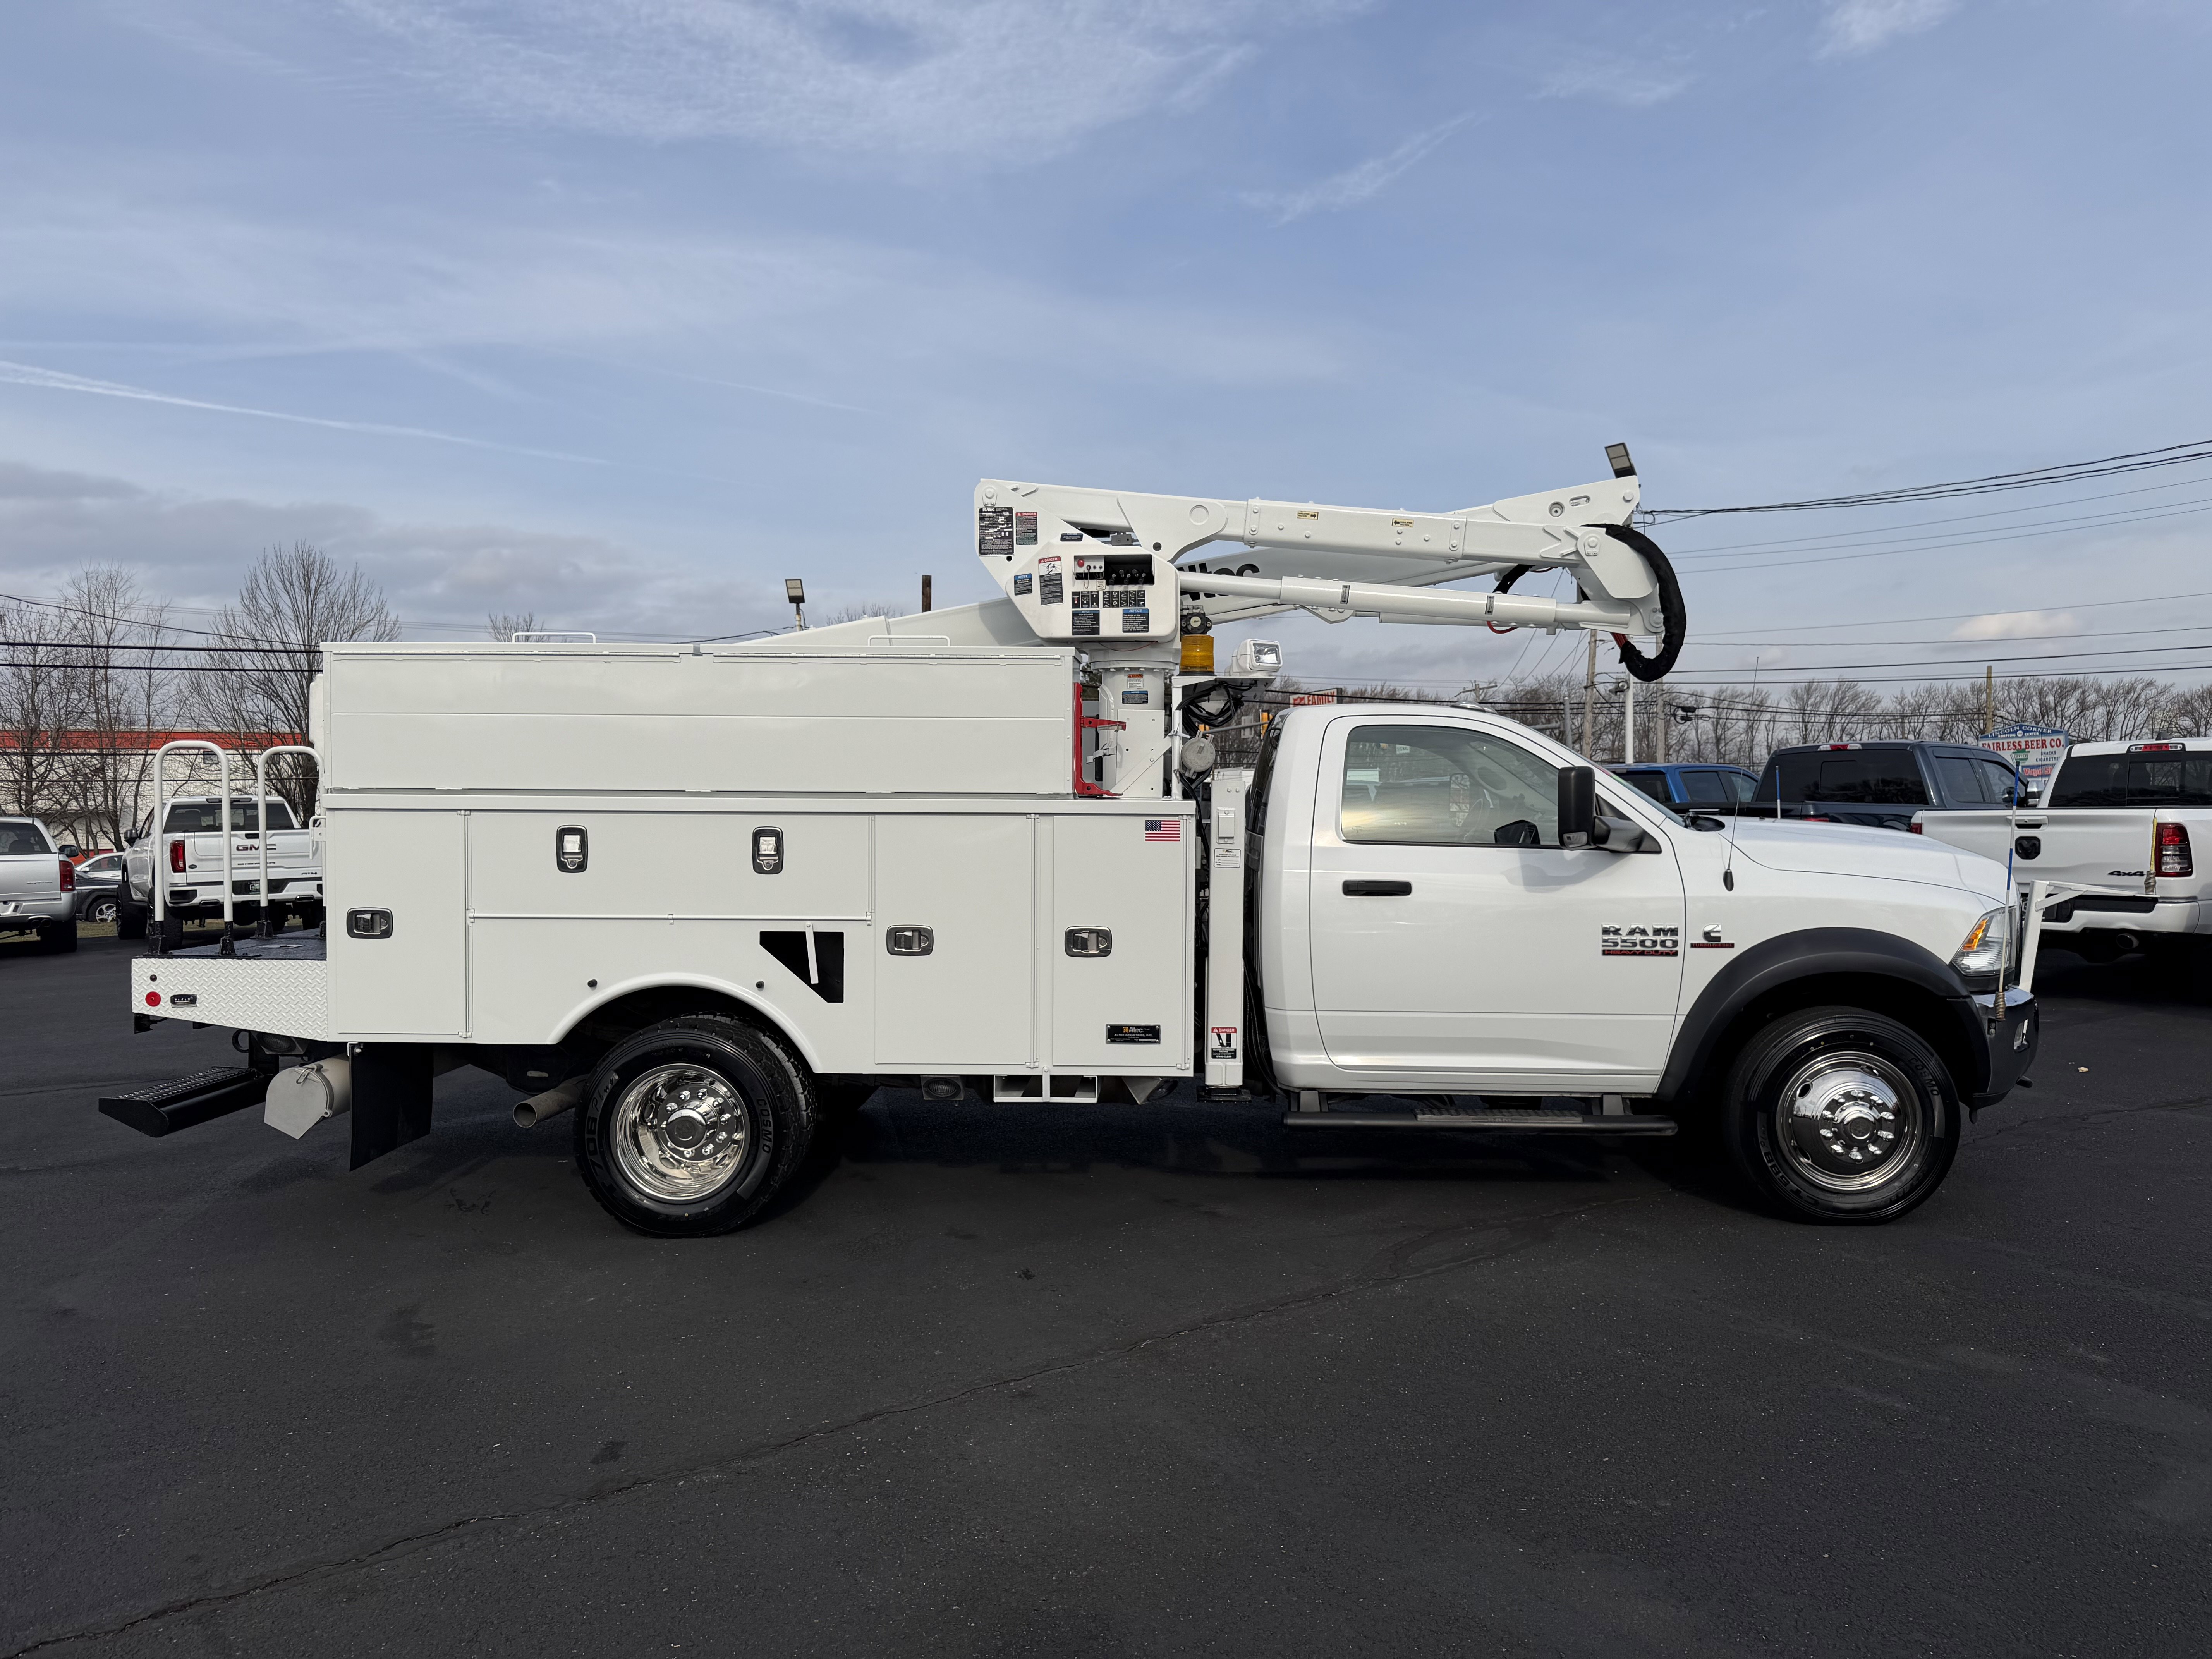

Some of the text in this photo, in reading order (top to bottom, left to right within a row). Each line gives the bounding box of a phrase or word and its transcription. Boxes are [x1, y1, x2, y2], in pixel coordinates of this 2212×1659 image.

[1307, 691, 1335, 705] FAMILY
[1989, 726, 2020, 738] LINCOLN
[1982, 738, 2064, 751] FAIRLESS BEER CO.
[1601, 924, 1679, 936] RAM
[1601, 936, 1679, 948] 5500
[1908, 1058, 1939, 1096] COSMO
[756, 1099, 772, 1154] COSMO
